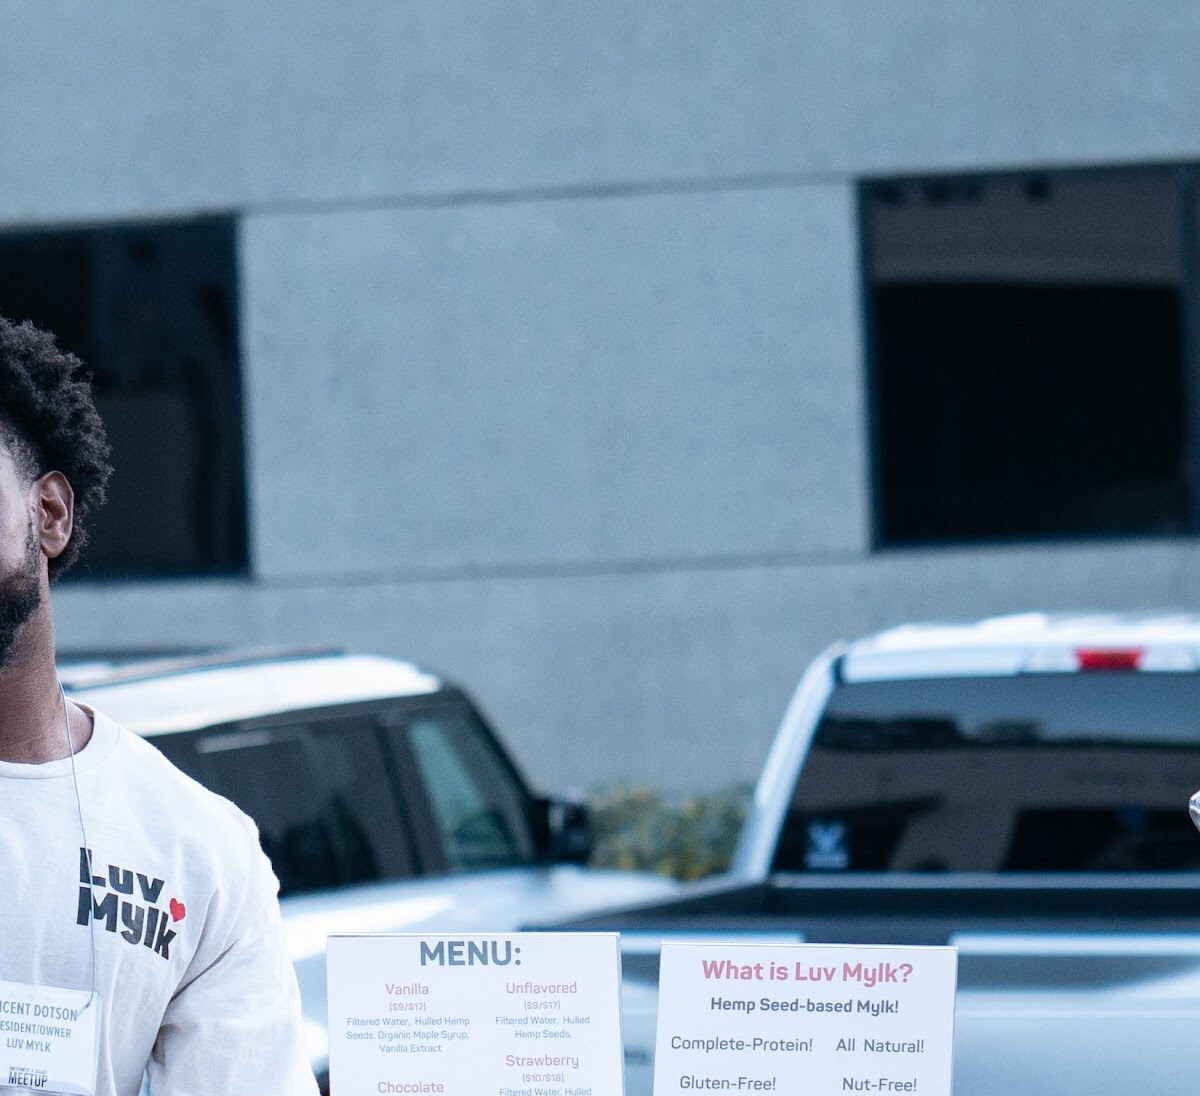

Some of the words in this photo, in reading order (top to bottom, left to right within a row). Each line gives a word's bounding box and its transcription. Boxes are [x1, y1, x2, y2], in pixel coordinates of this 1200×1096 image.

[80, 846, 165, 904] Luv
[76, 886, 177, 960] Mylk
[420, 940, 522, 966] MENU:
[702, 960, 763, 980] What
[769, 960, 789, 982] is
[795, 962, 836, 982] Luv
[842, 962, 913, 988] Mylk?
[385, 983, 429, 995] Vanilla
[506, 982, 577, 994] Unflavored
[34, 1004, 78, 1022] DOTSON
[710, 997, 756, 1013] Hemp
[760, 998, 852, 1013] Seed-based
[857, 1000, 898, 1016] Mylk!
[347, 1017, 380, 1026] Filtered
[382, 1018, 411, 1026] Water,
[415, 1017, 442, 1026] Hulled
[444, 1018, 470, 1027] Hemp
[495, 1016, 528, 1025] Filtered
[530, 1016, 559, 1025] Water,
[562, 1016, 590, 1024] Hulled
[378, 1031, 411, 1042] Organic
[413, 1030, 439, 1040] Maple
[441, 1030, 469, 1040] Syrup,
[514, 1030, 540, 1039] Hemp
[6, 1037, 24, 1050] LUV
[26, 1040, 51, 1052] MYLK
[380, 1044, 408, 1053] Vanilla
[410, 1044, 442, 1053] Extract
[670, 1036, 813, 1054] Complete-Protein!
[836, 1038, 856, 1052] All
[864, 1038, 924, 1053] Natural!
[506, 1054, 579, 1069] Strawberry
[8, 1071, 48, 1088] MEETUP
[679, 1076, 776, 1091] Gluten-Free!
[842, 1077, 916, 1092] Nut-Free!
[377, 1082, 444, 1094] Chocolate
[499, 1088, 532, 1096] Filtered
[534, 1088, 562, 1096] Water,
[564, 1088, 592, 1096] Hulled
